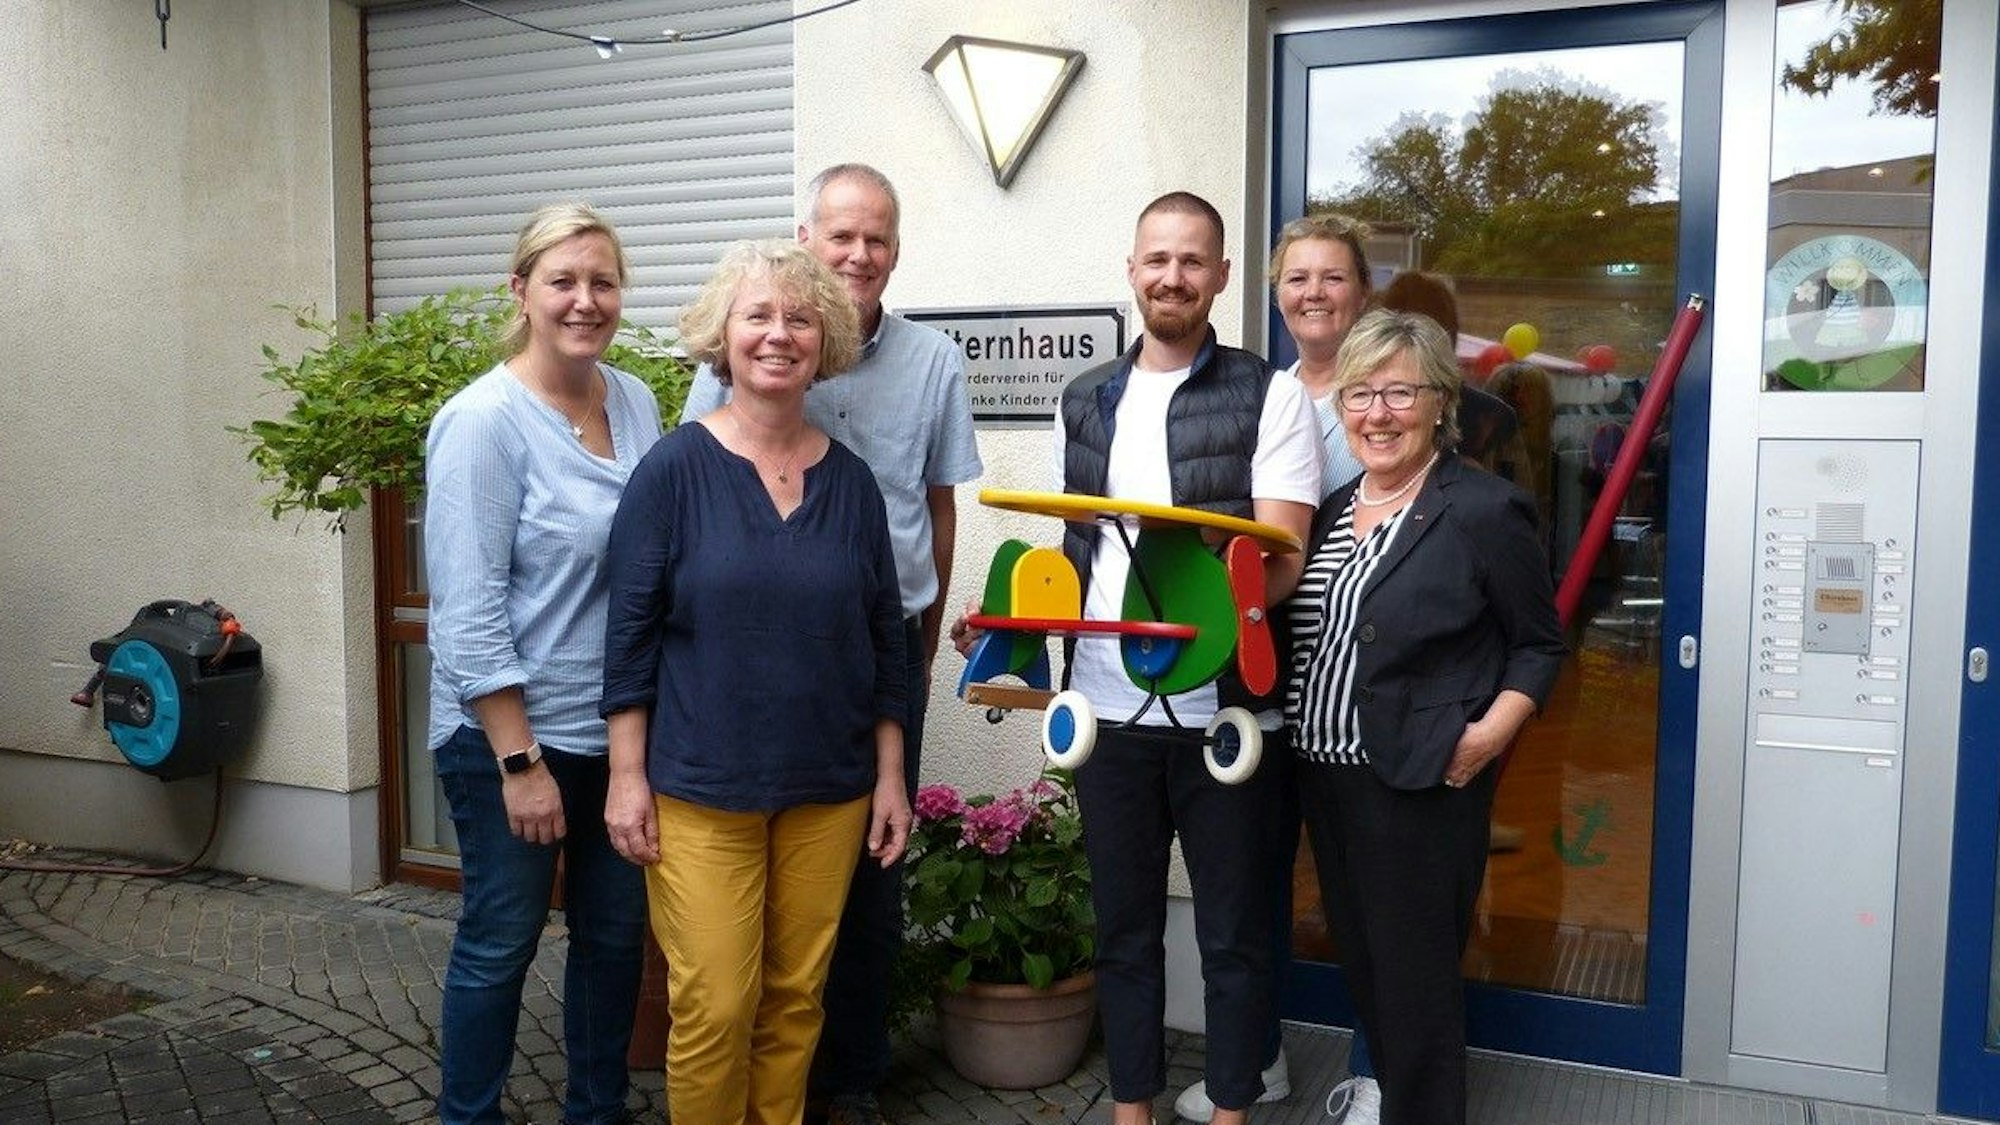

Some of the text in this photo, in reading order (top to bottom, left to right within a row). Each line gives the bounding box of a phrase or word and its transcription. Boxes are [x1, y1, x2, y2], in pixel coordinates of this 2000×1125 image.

[940, 327, 1094, 361] ternhaus
[967, 372, 1065, 385] rderverein für
[971, 394, 996, 406] nke
[1000, 394, 1046, 406] Kinder
